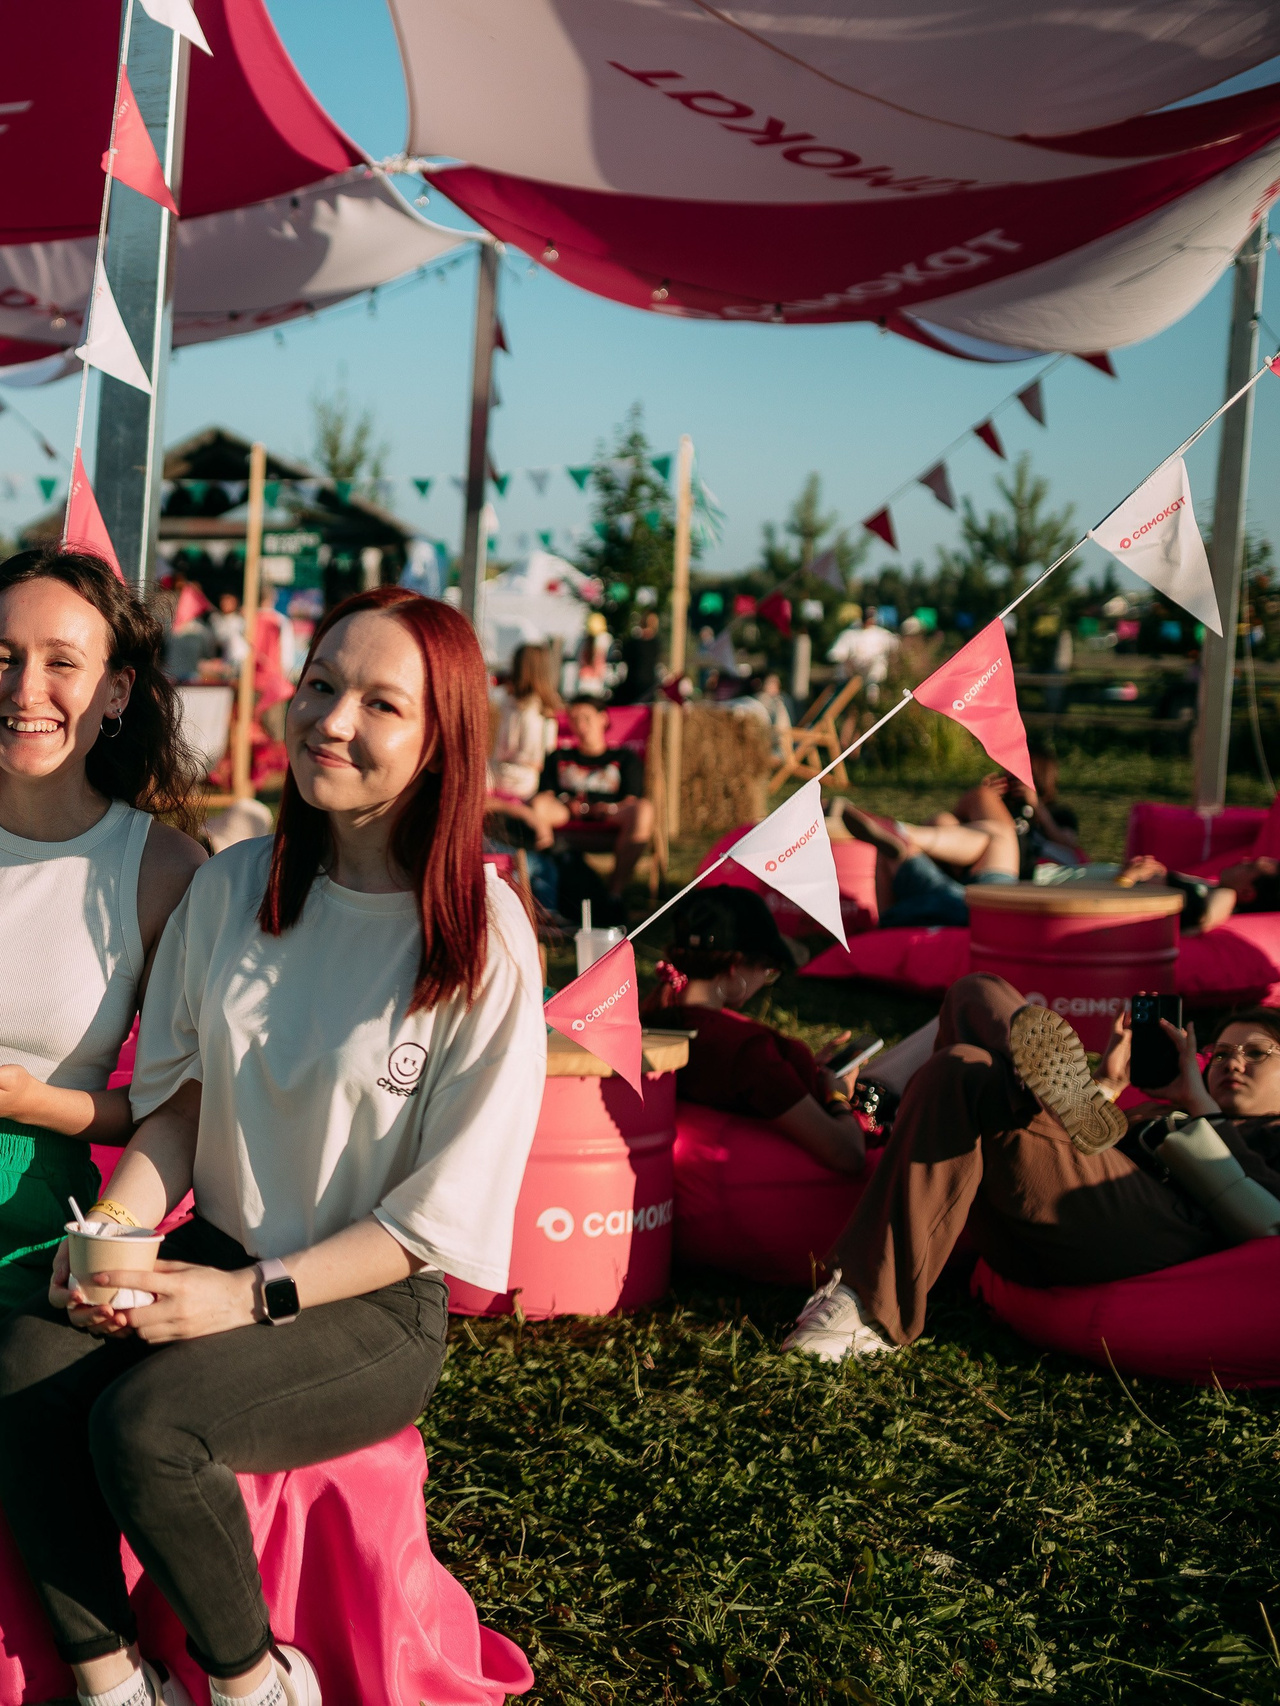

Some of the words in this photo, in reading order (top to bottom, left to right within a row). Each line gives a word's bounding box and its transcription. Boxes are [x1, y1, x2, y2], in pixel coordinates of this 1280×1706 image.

[1132, 495, 1187, 540] самокат
[963, 657, 1003, 702] самокат
[777, 818, 820, 863] самокат
[585, 979, 631, 1023] самокат
